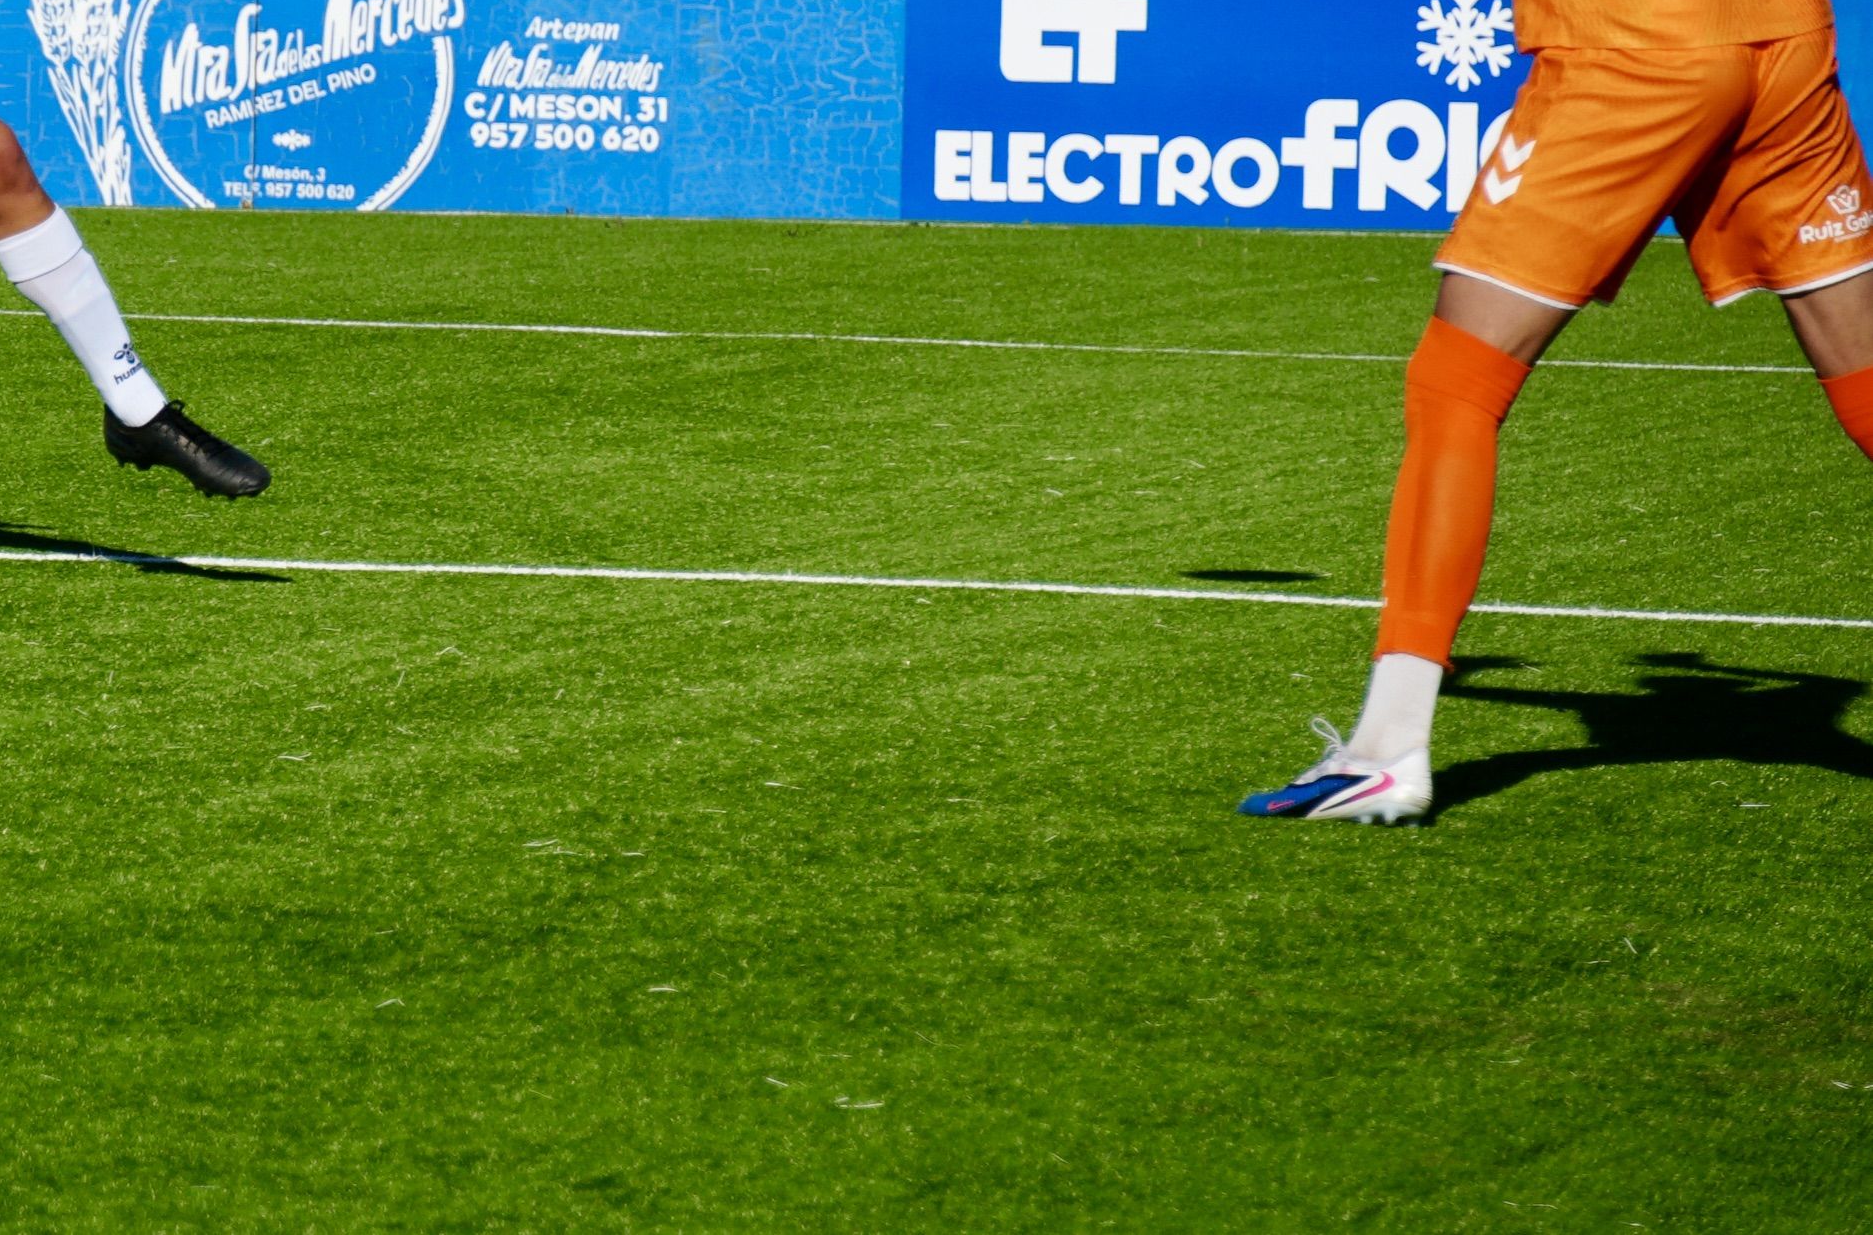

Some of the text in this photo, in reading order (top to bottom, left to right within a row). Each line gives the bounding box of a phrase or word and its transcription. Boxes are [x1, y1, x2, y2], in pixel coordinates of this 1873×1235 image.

[525, 16, 620, 43] Artepan
[204, 62, 378, 130] RAMIREZ DEL PINO
[635, 95, 669, 124] 31
[469, 120, 661, 154] 957 500 620
[265, 183, 294, 198] 957
[295, 184, 324, 198] 500
[326, 185, 355, 200] 620
[1799, 220, 1845, 245] Ruiz
